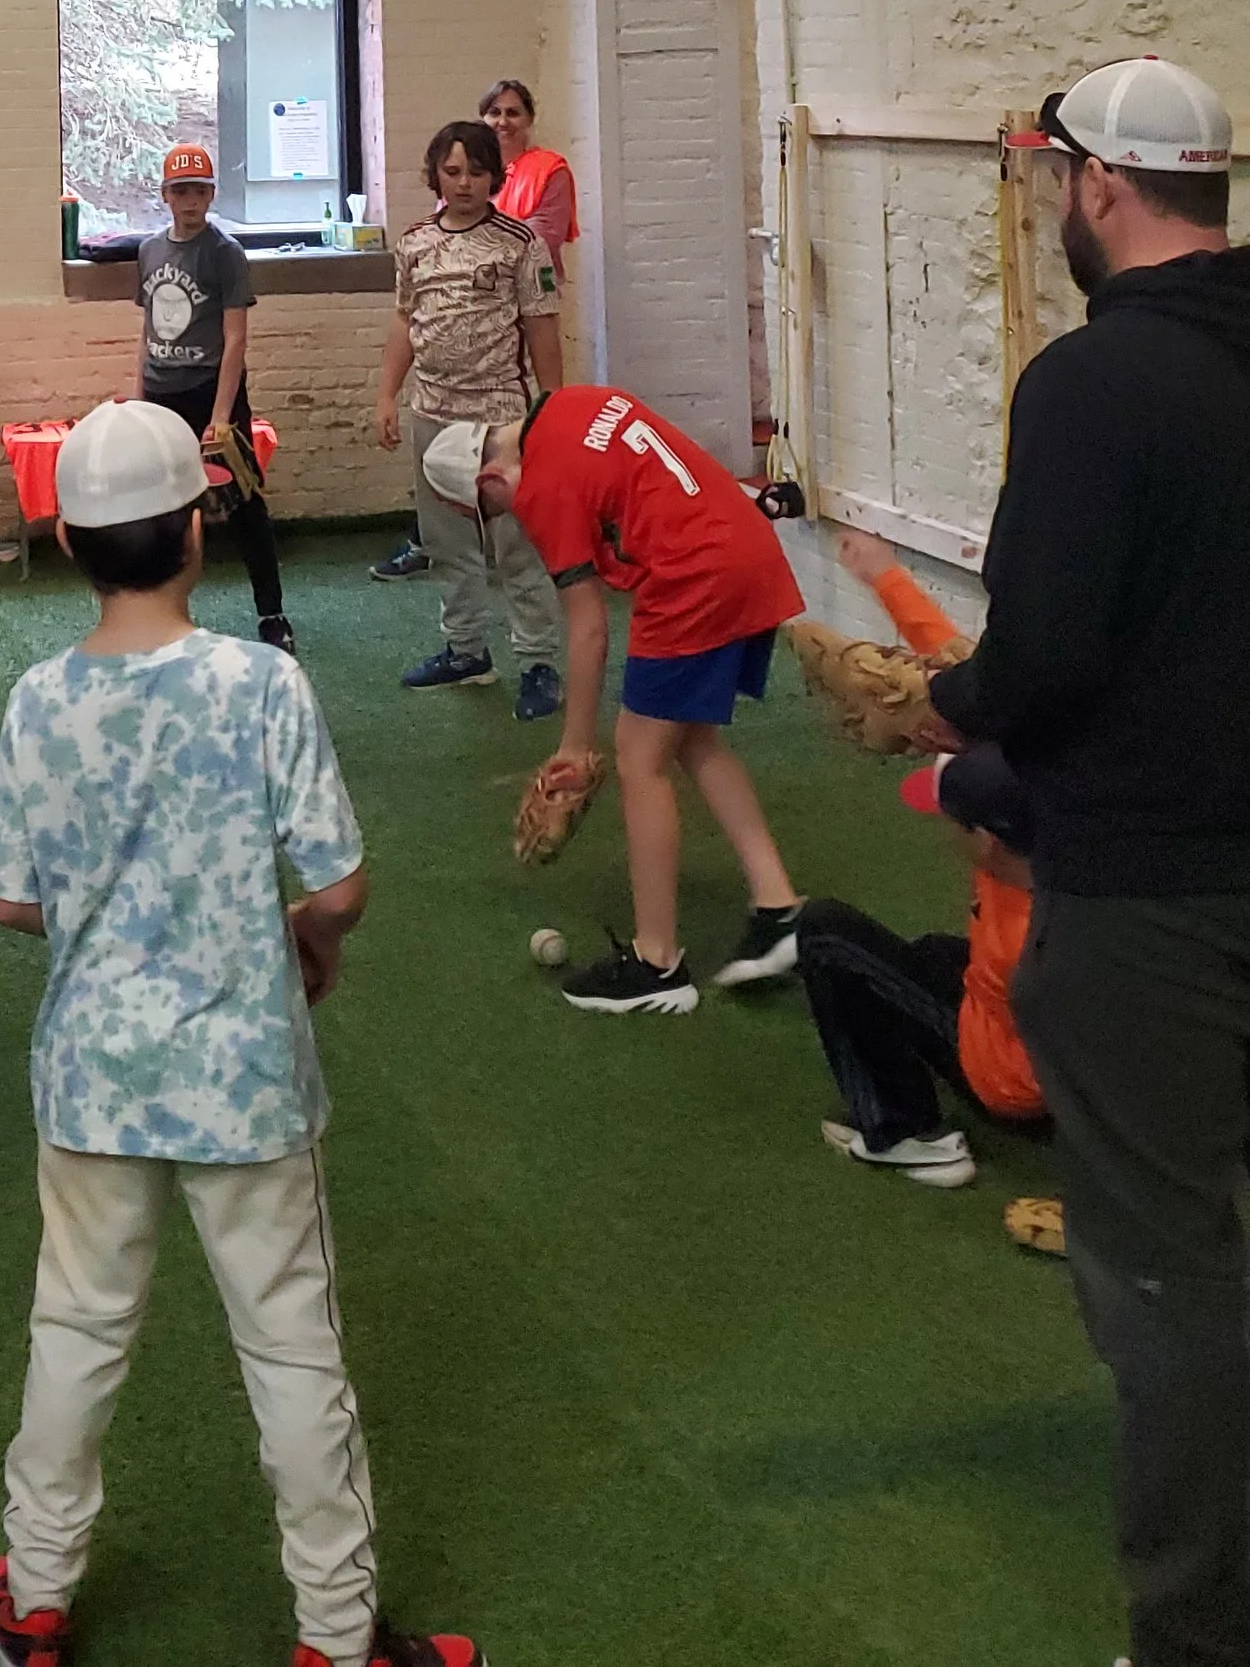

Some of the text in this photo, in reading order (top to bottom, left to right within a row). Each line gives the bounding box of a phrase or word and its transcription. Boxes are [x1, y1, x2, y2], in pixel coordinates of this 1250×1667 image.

[147, 338, 205, 359] ackers
[583, 395, 633, 452] RONALDO
[621, 419, 700, 496] 7
